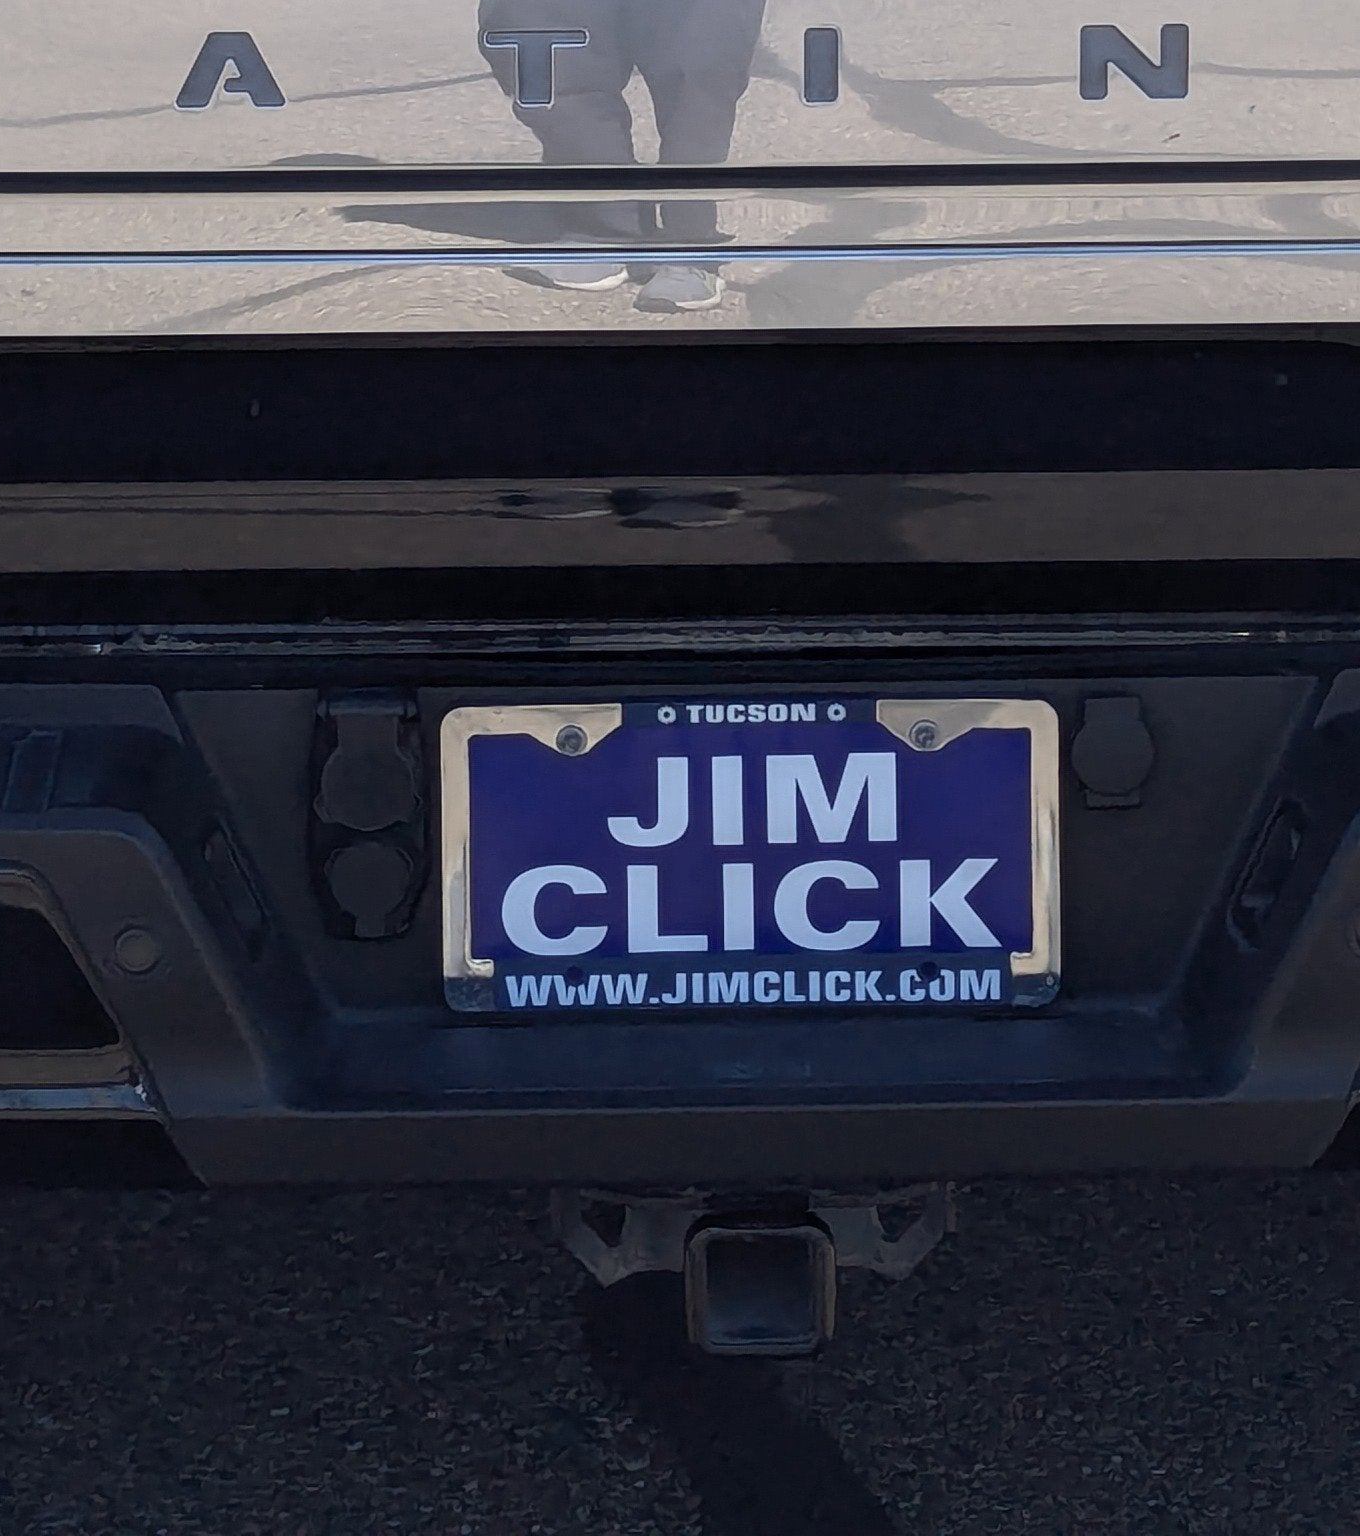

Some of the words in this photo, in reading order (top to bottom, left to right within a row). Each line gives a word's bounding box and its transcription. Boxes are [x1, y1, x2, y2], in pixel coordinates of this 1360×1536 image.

[686, 703, 816, 724] TUCSON
[607, 751, 898, 848] JIM
[501, 858, 1003, 956] CLICK
[504, 968, 1003, 1008] WWW.JIMCLICK.COM
